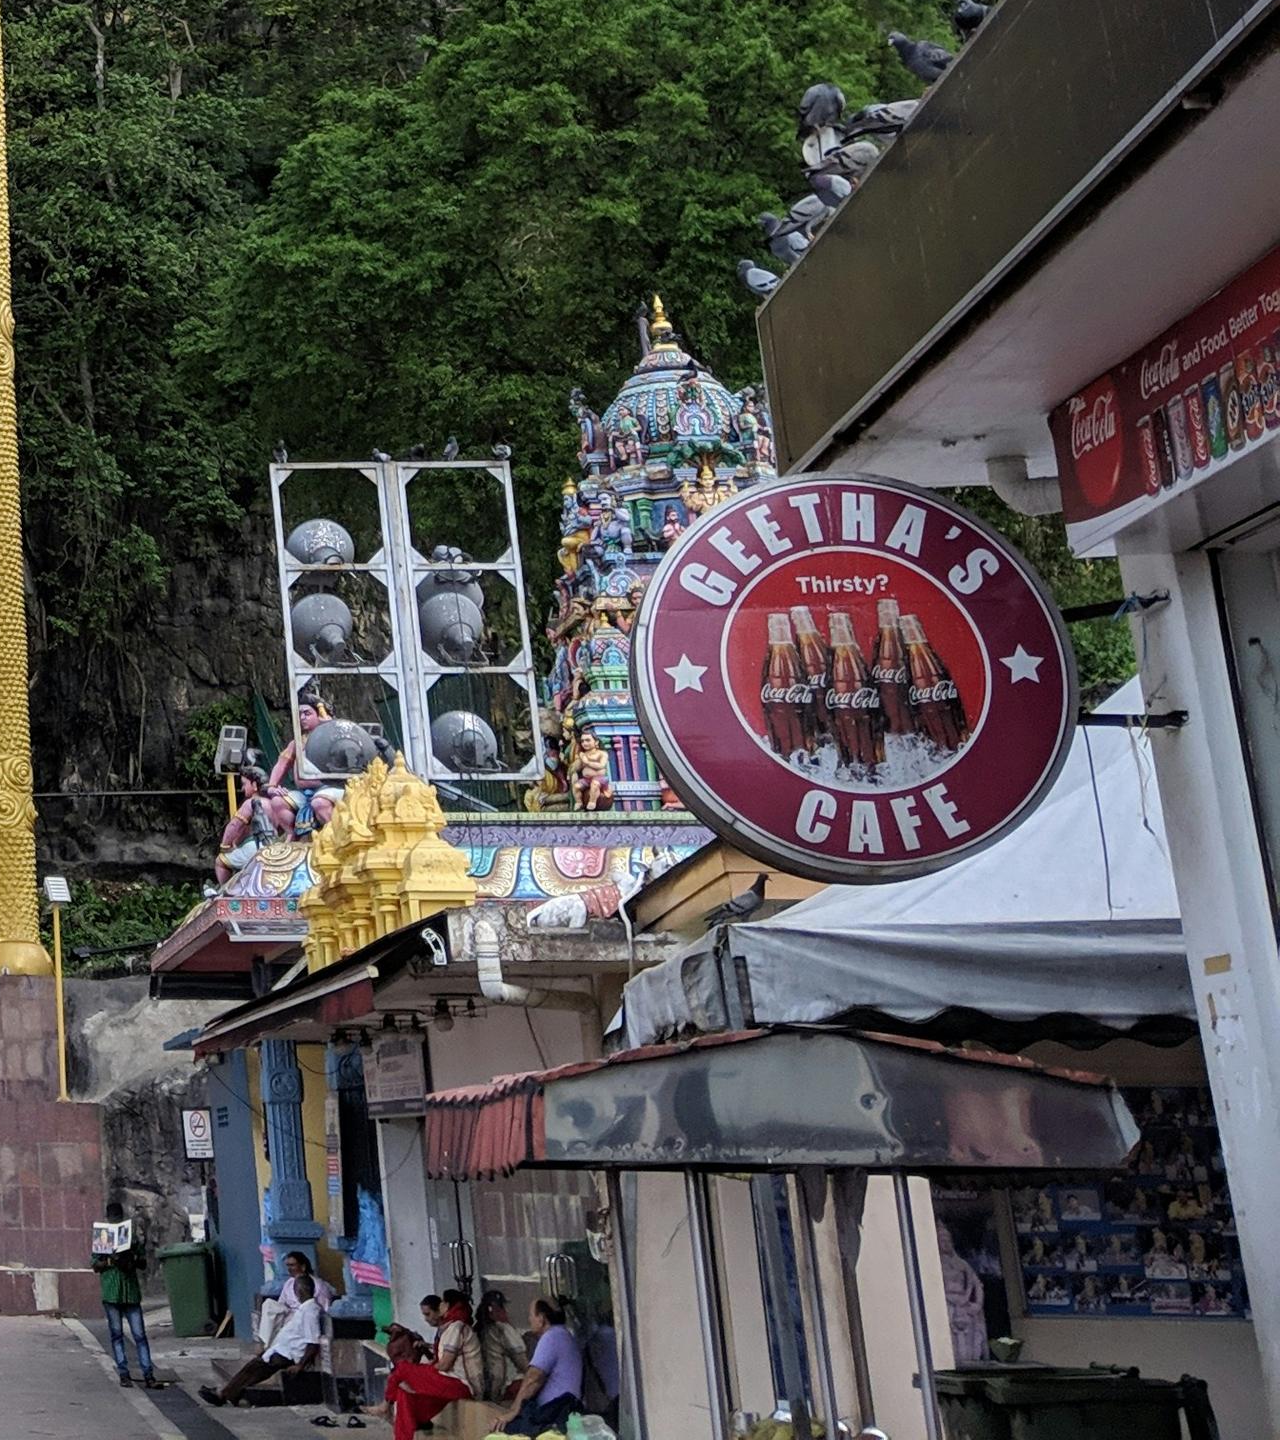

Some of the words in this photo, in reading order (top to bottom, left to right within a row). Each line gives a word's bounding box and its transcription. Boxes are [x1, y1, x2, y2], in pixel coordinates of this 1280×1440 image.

[1182, 342, 1201, 371] and
[1228, 304, 1259, 339] Better
[679, 491, 1001, 607] GEETHA'S
[795, 574, 889, 595] Thirsty?
[795, 782, 971, 855] CAFE
